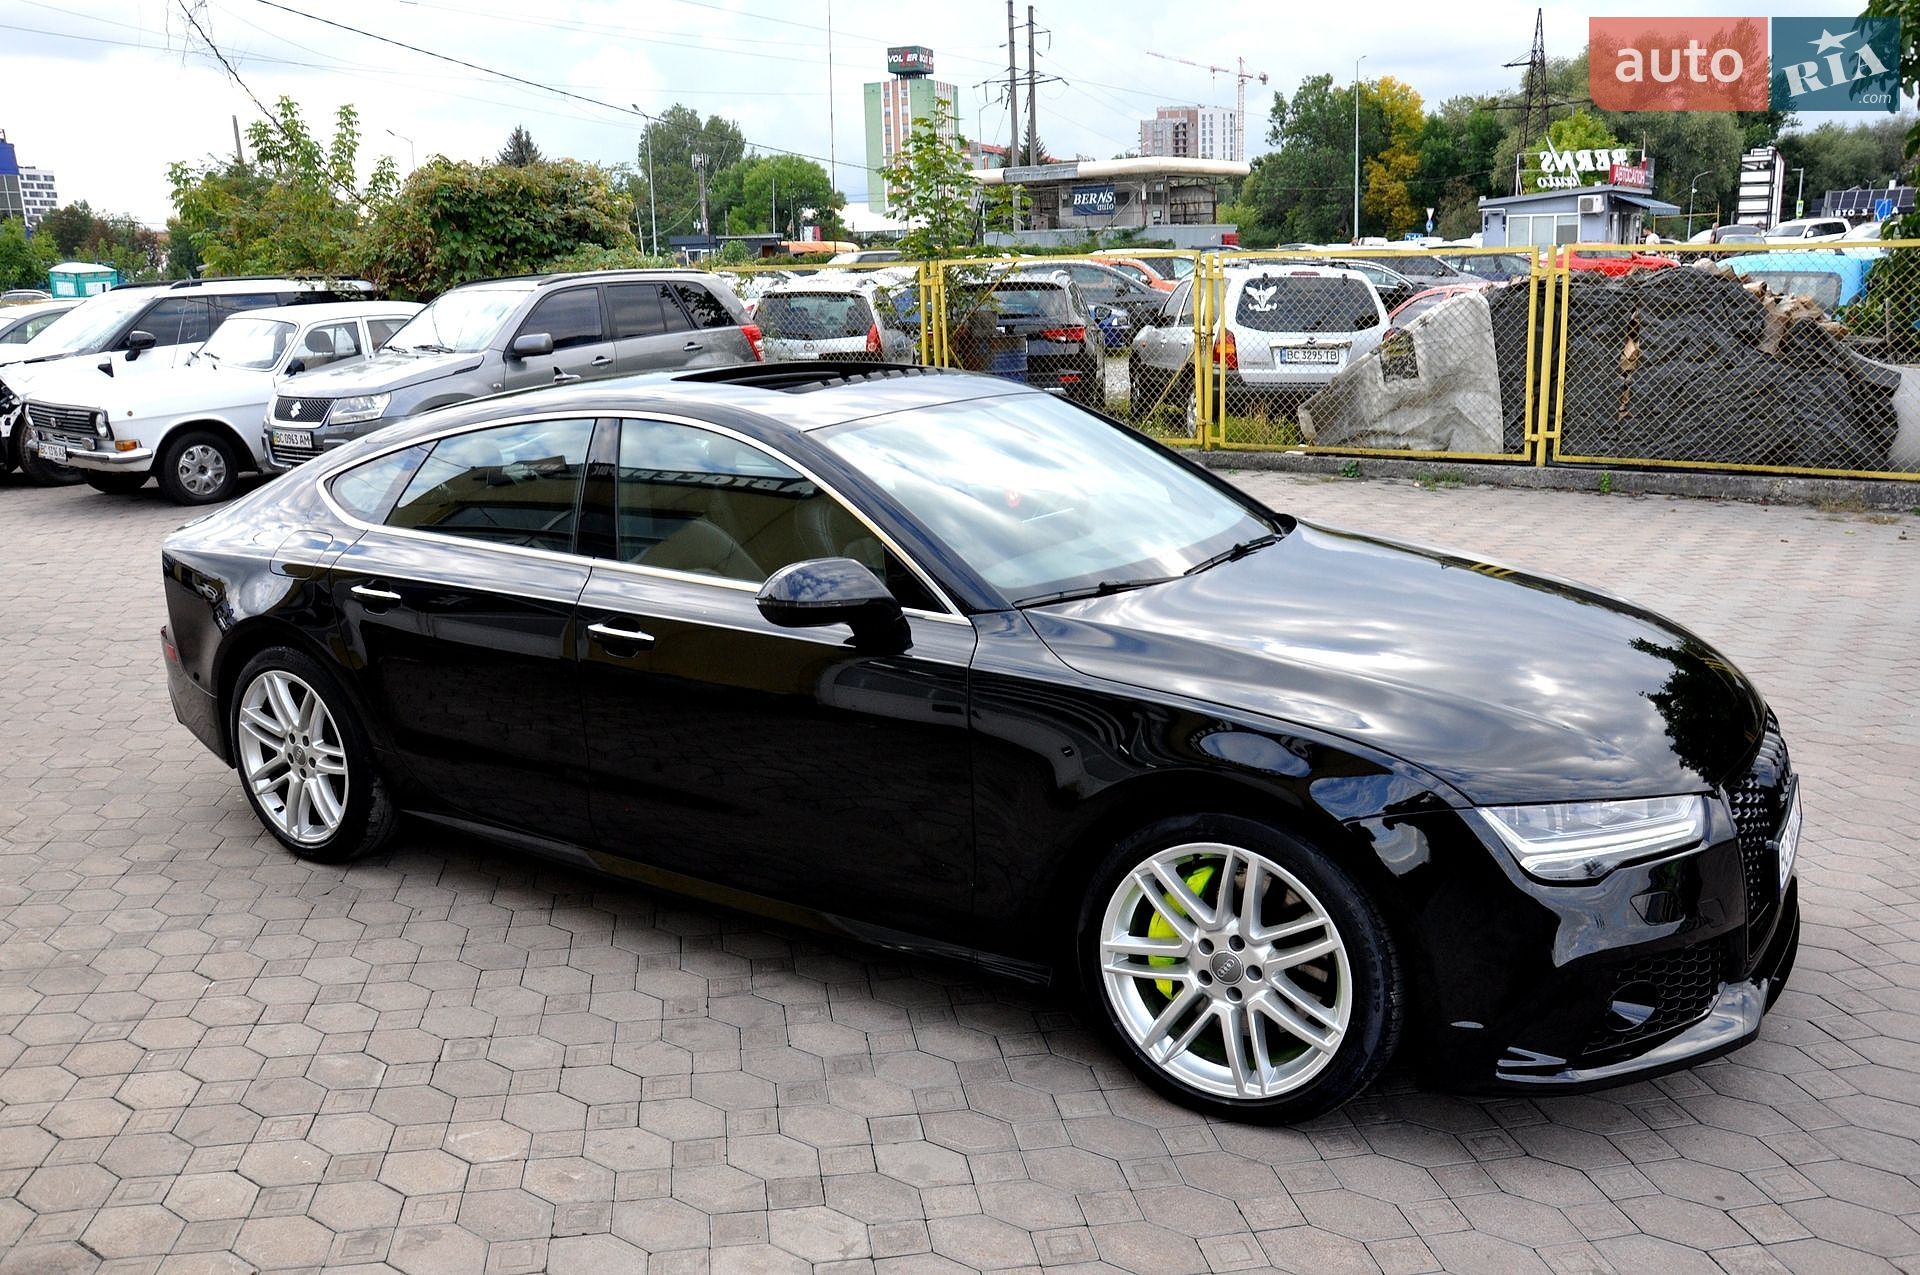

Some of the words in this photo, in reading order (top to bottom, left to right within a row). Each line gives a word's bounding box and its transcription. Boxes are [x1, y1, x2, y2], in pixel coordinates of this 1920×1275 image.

[1073, 189, 1114, 205] BERNS
[1287, 350, 1300, 360] BC
[1302, 350, 1322, 360] 3295
[1324, 350, 1337, 360] TB
